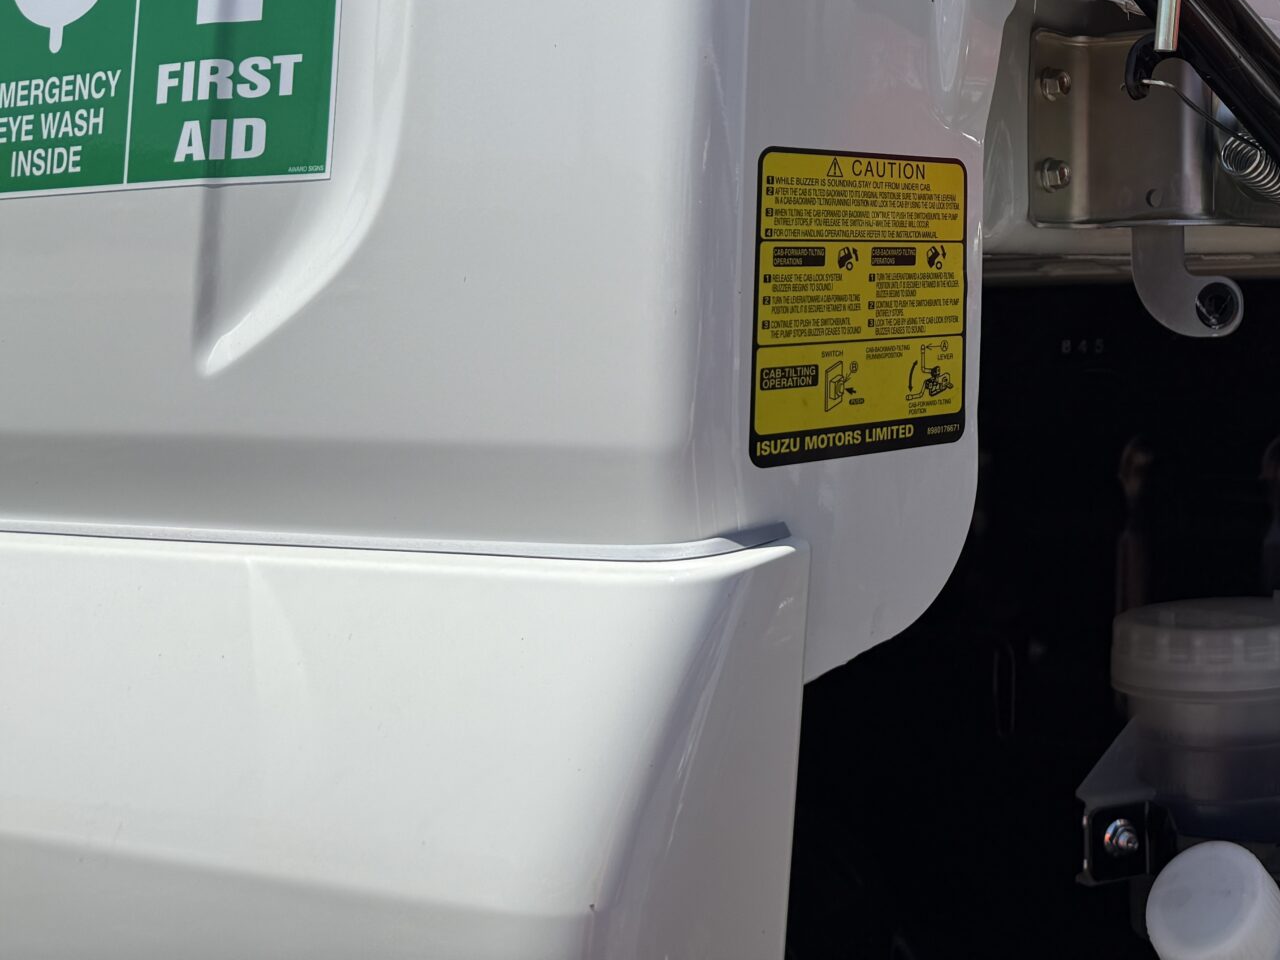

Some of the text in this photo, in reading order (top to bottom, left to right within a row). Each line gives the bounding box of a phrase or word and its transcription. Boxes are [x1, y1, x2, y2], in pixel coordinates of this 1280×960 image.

[156, 53, 303, 105] FIRST
[0, 69, 121, 109] MERGENCY
[40, 107, 104, 140] WASH
[173, 117, 267, 163] AID
[10, 145, 82, 178] INSIDE
[851, 159, 926, 179] CAUTION
[774, 176, 919, 191] WHILE BUZZER OUT FROM UNDER
[783, 228, 800, 237] OTHER
[773, 257, 803, 265] OPERATIONS
[772, 274, 792, 282] RELEASE
[821, 349, 843, 358] SWITCH
[937, 352, 953, 360] LEVER
[762, 365, 816, 379] CAB-TILTING
[762, 375, 812, 389] OPERATION
[755, 423, 913, 456] ISUZU MOTORS LIMITED
